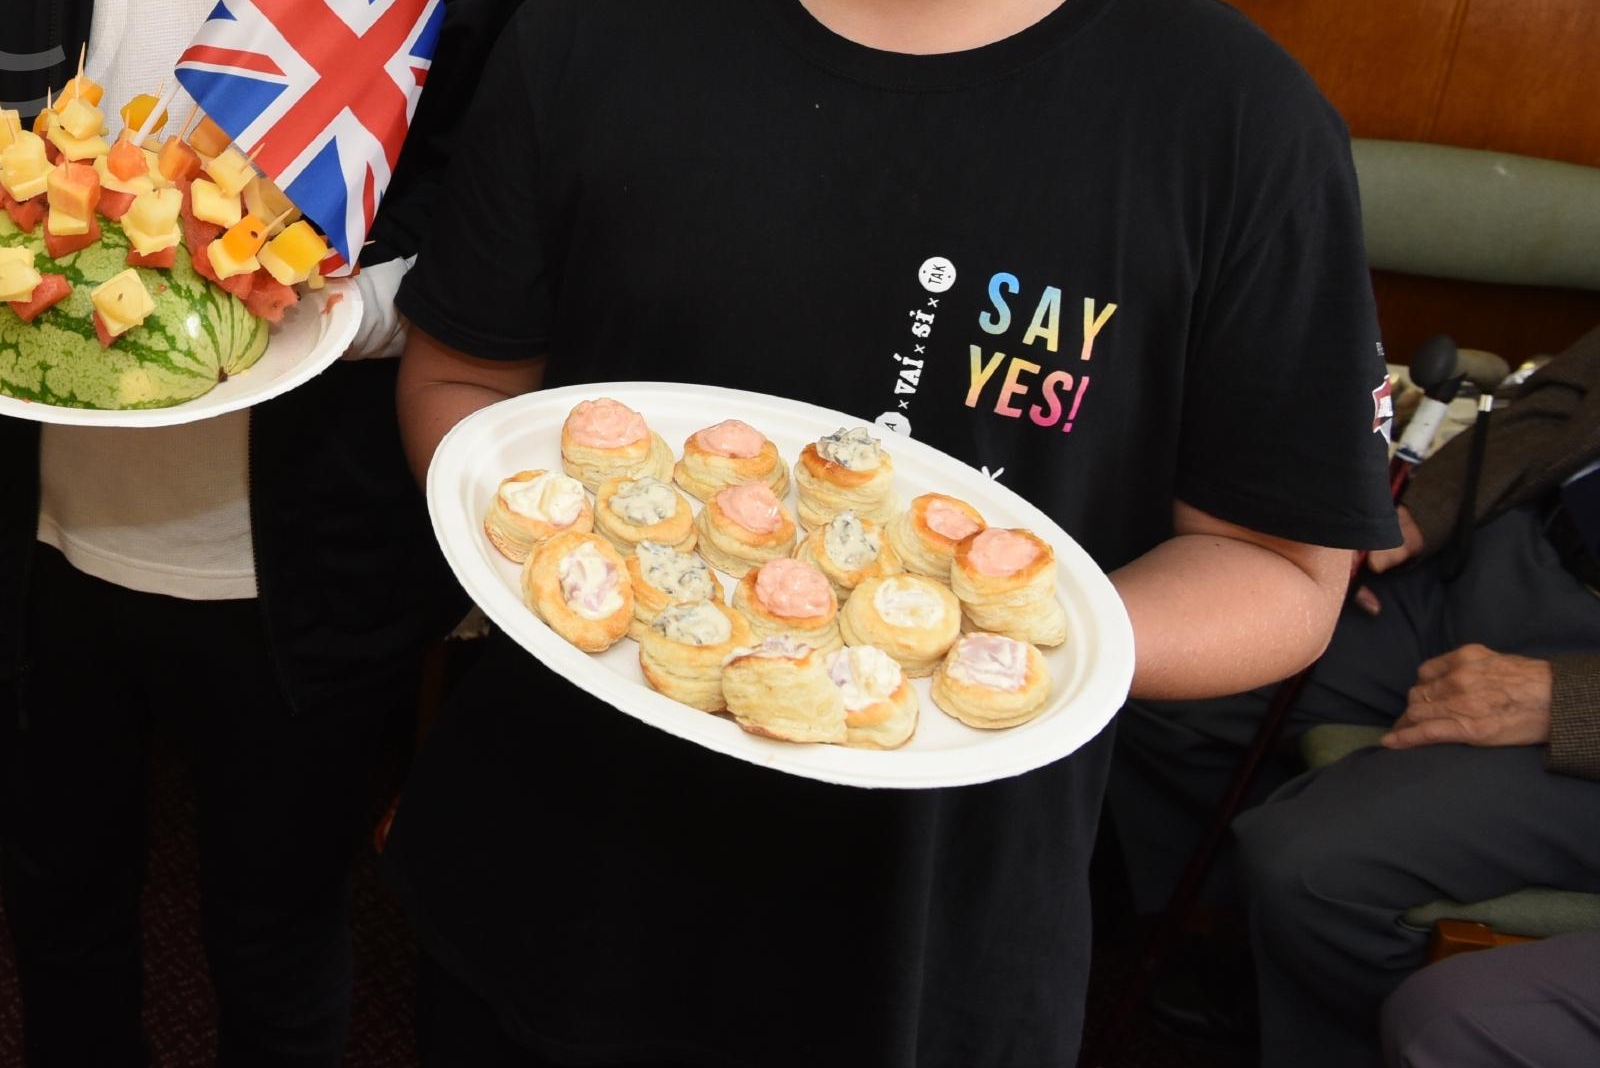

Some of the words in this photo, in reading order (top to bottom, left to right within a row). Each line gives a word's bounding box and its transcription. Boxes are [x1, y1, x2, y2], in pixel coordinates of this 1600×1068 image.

[928, 264, 947, 284] TAK
[978, 272, 1118, 361] SAY
[964, 344, 1090, 433] YES!
